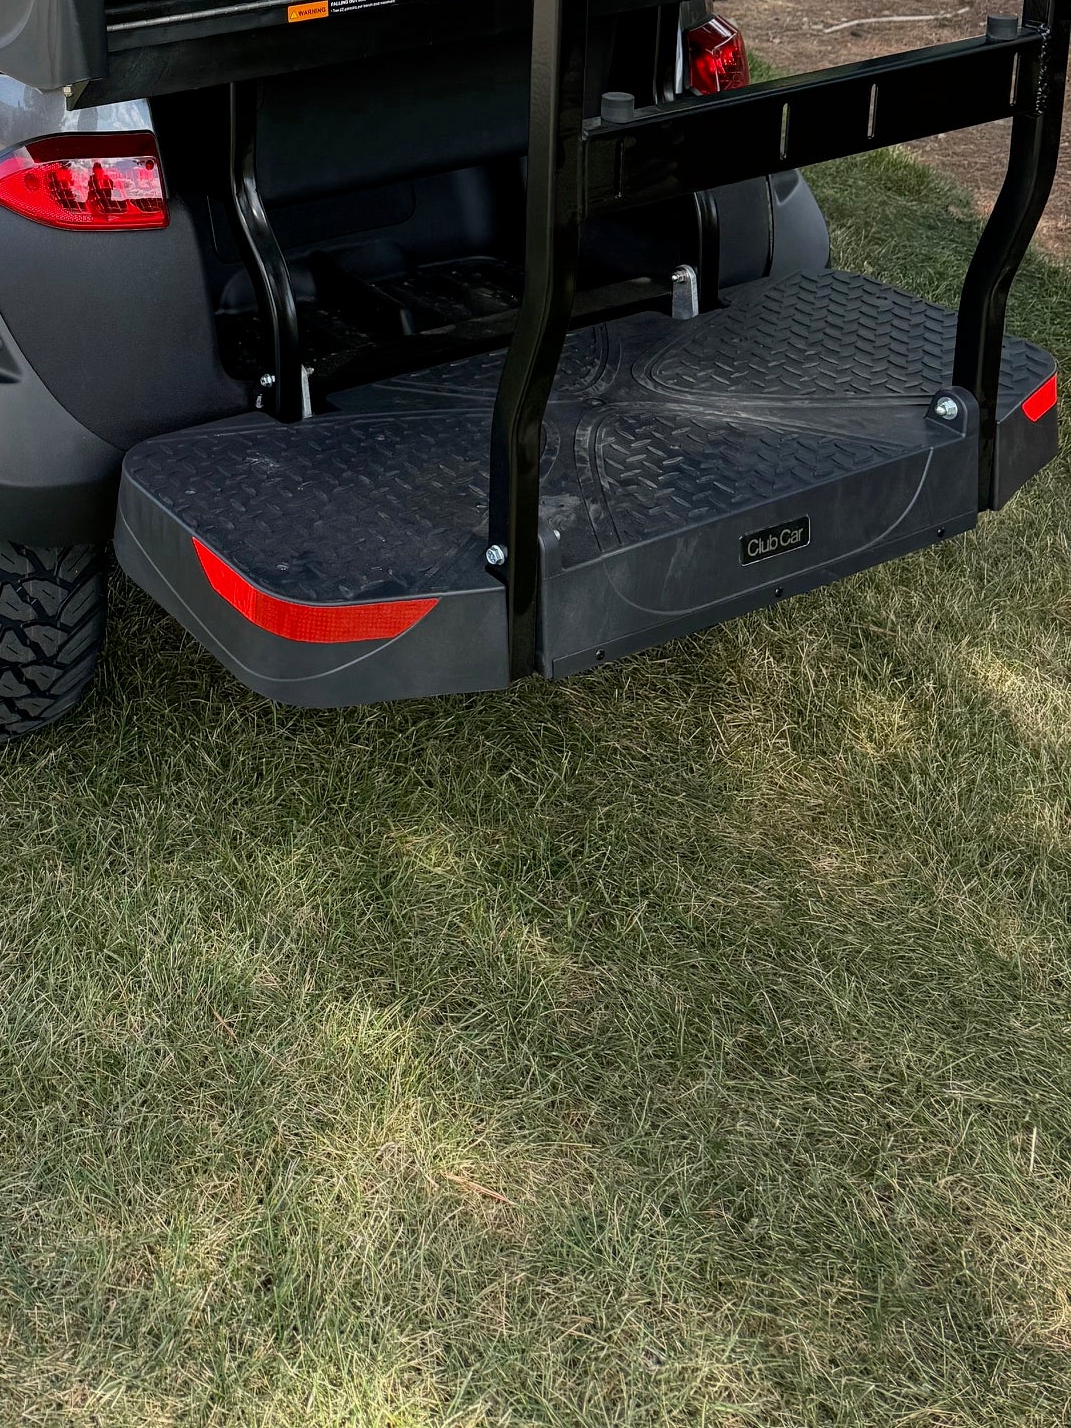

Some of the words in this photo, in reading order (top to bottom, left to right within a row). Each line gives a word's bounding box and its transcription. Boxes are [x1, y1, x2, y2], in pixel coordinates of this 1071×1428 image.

[298, 6, 326, 18] WARNING
[747, 534, 779, 557] Club
[779, 527, 804, 547] Car
